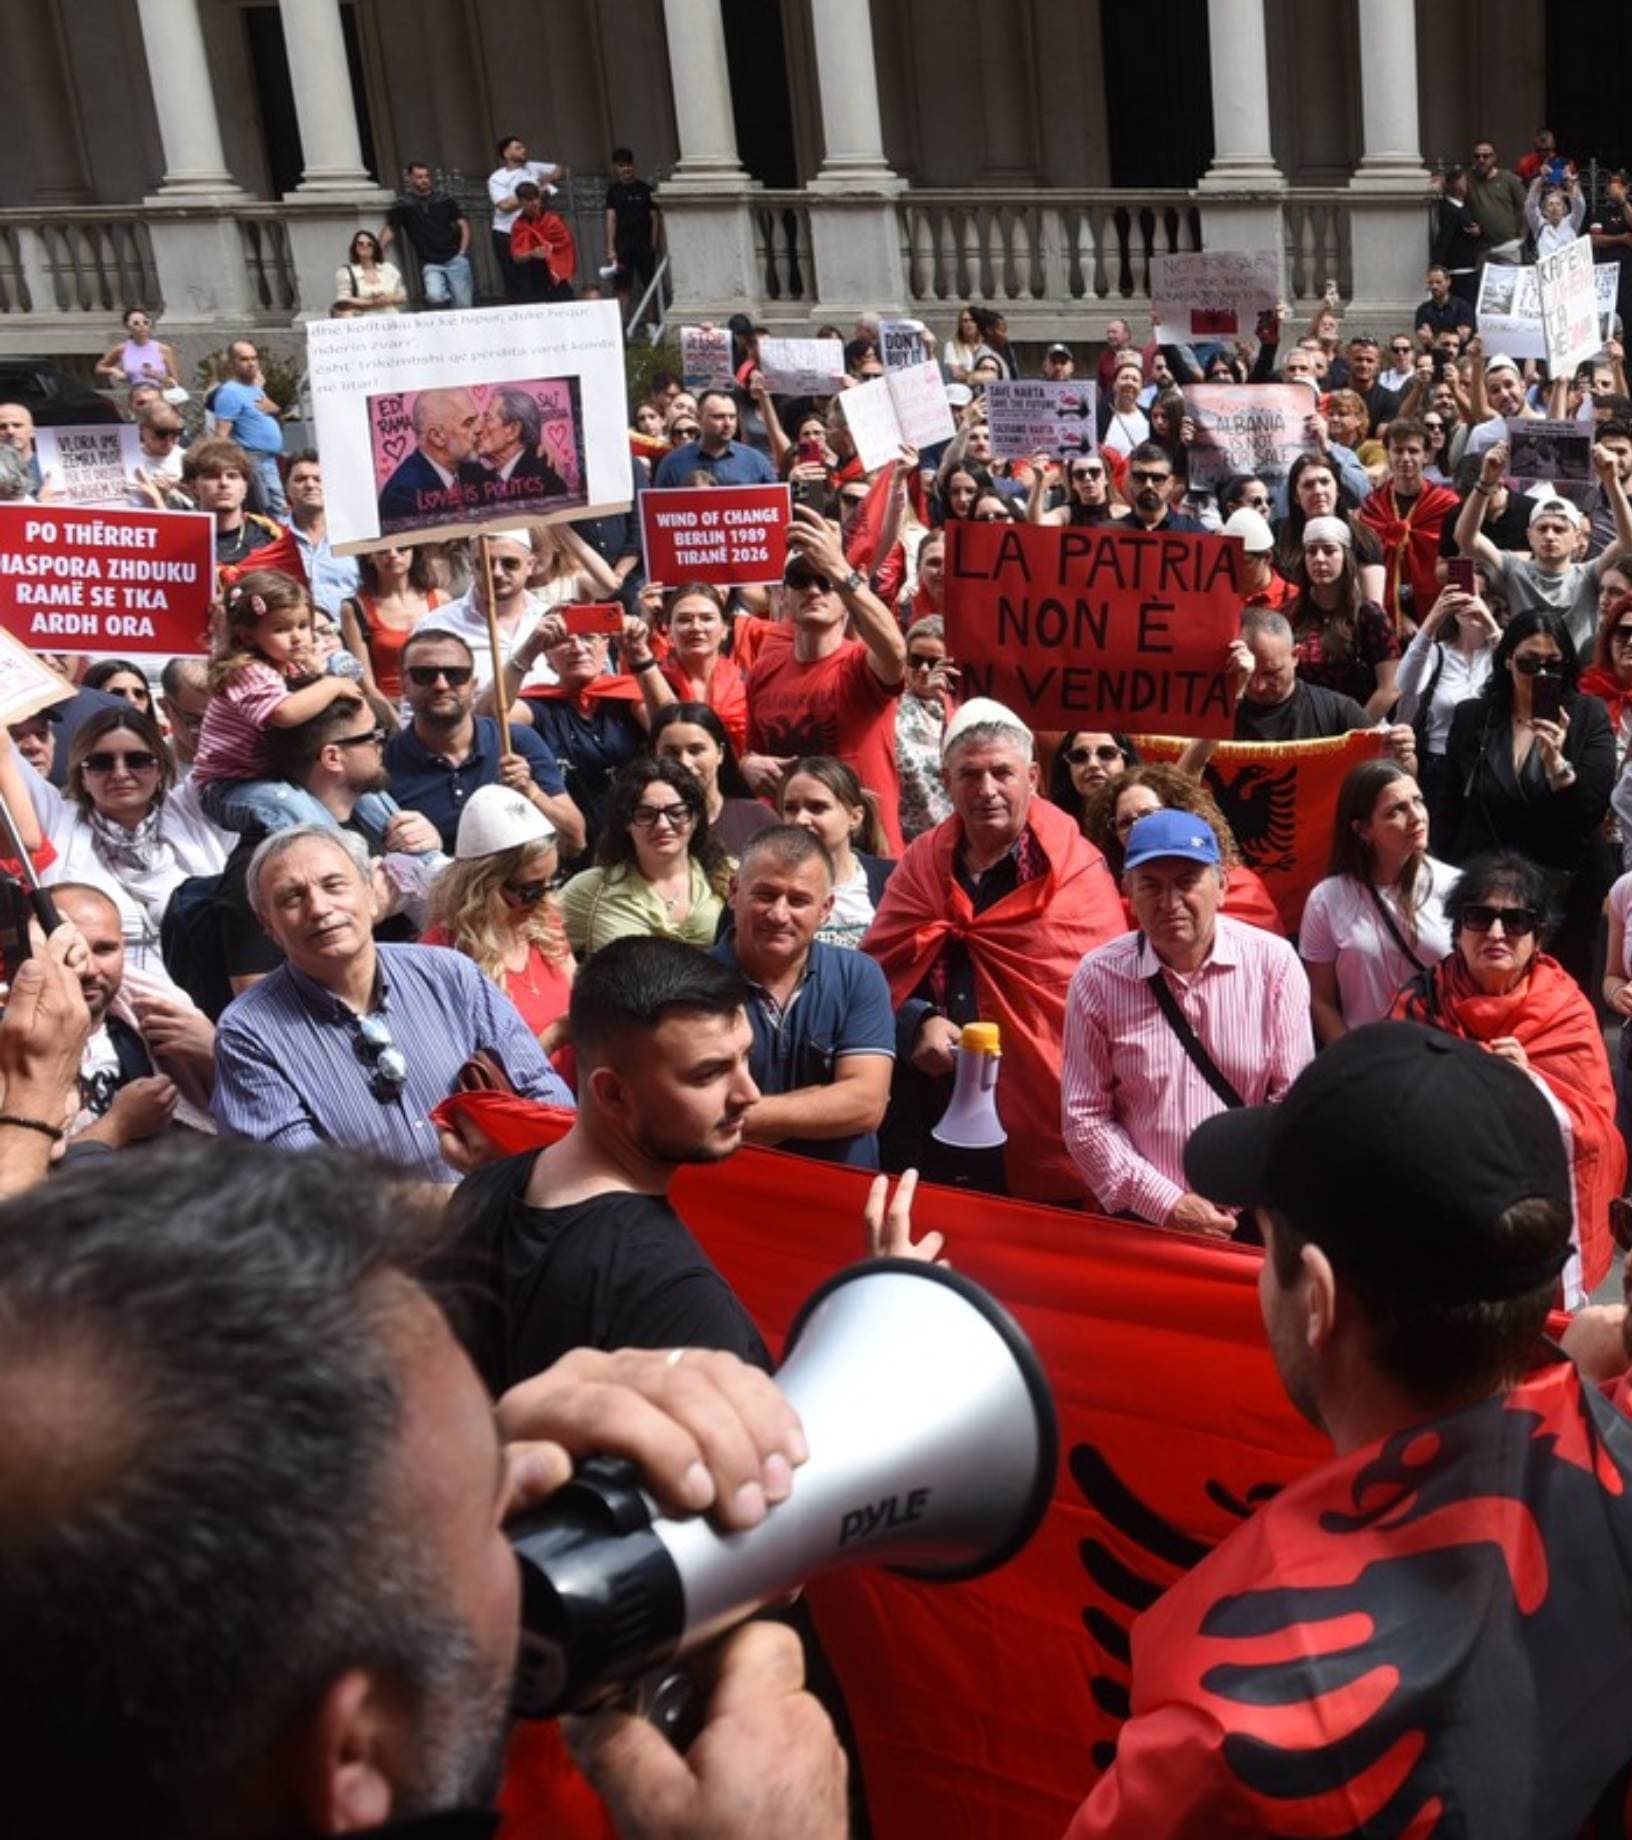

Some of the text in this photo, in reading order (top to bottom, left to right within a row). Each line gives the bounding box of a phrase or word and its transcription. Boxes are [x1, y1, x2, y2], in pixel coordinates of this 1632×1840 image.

[1216, 414, 1285, 435] ALBANIA
[656, 507, 779, 527] WIND OF CHANGE
[25, 520, 158, 548] PO THËRRET
[673, 528, 766, 546] BERLIN 1989
[0, 553, 197, 583] IASPORA ZHDUKU
[675, 545, 768, 566] TIRANË 2026
[953, 527, 1239, 593] LA PATRIA
[16, 580, 168, 610] RAMË SE TKA
[30, 612, 155, 637] ARDH ORA
[997, 595, 1175, 653] NON È
[1016, 665, 1232, 718] VENDITA
[837, 1486, 933, 1547] PYLE
